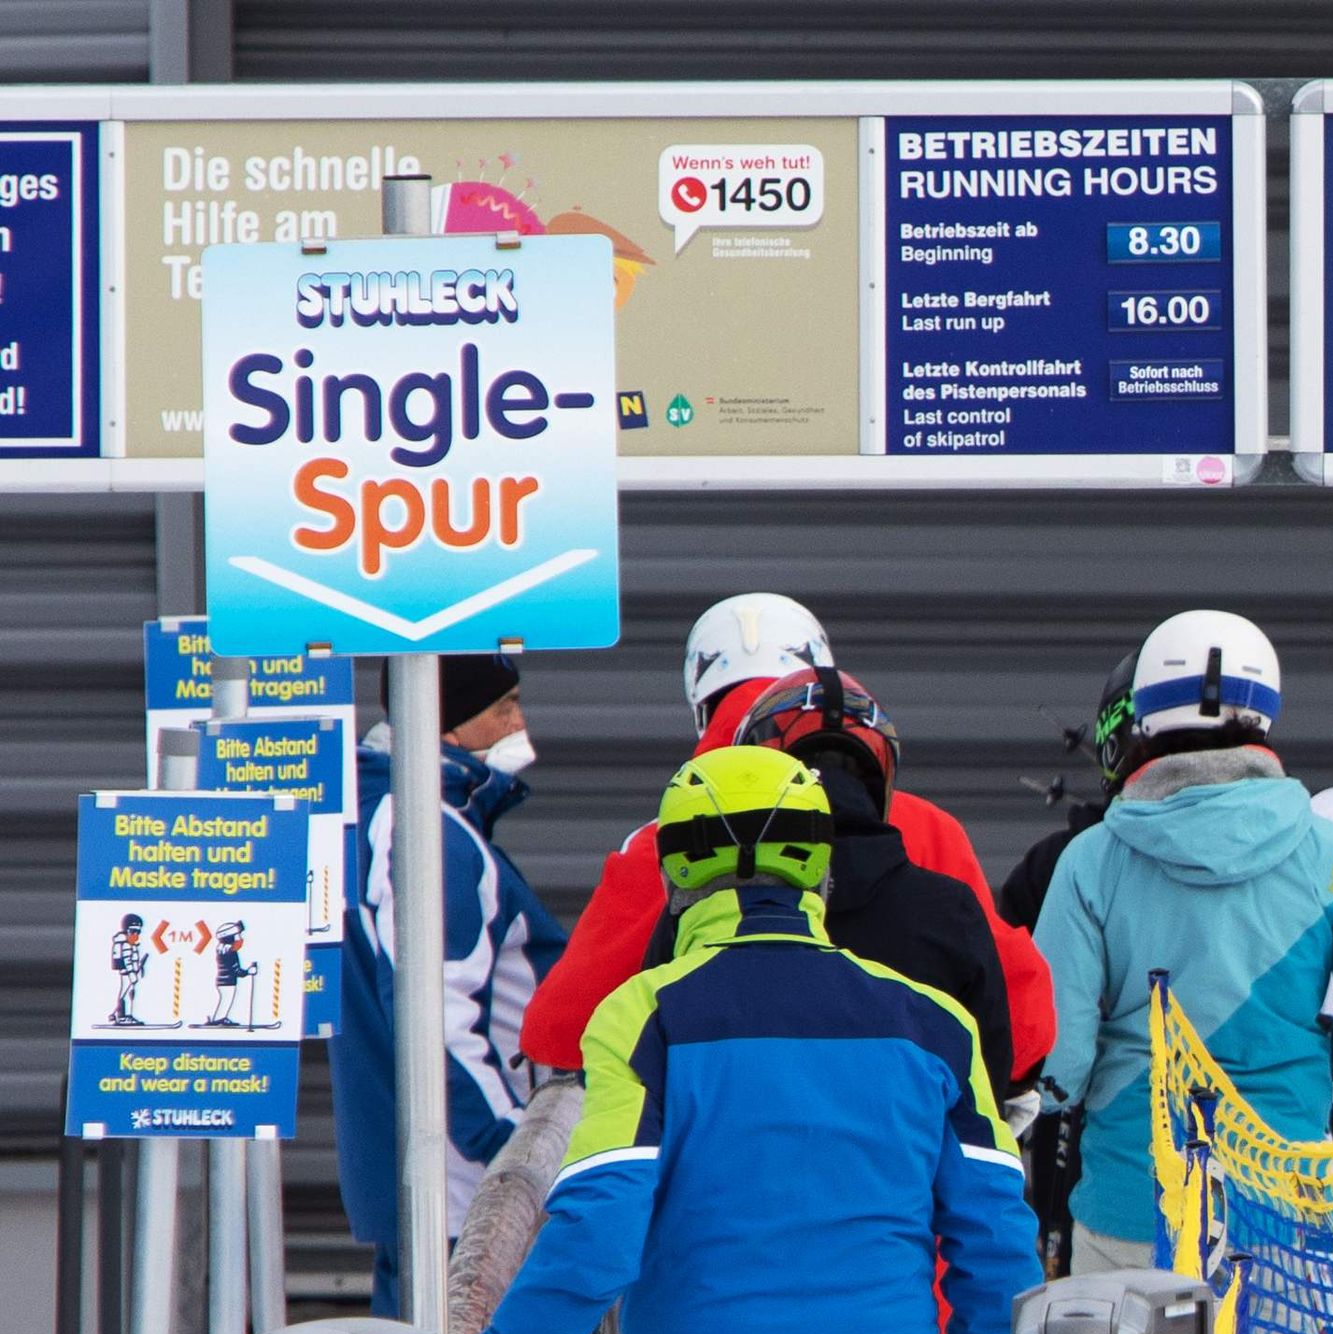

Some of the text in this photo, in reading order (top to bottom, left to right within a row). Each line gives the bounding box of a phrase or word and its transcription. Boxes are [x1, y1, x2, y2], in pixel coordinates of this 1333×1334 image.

[900, 128, 1217, 159] BETRIEBSZEITEN
[163, 146, 230, 191] Die
[673, 157, 810, 169] Wenn's weh tut!
[900, 167, 1217, 198] RUNNING HOURS
[711, 177, 811, 211] 1450
[163, 201, 336, 245] Hilfe am
[901, 222, 1038, 239] Betriebszeit ab
[1128, 226, 1200, 255] 8.30
[901, 246, 993, 263] Beginning
[297, 268, 517, 329] STUHLECK
[902, 291, 1050, 310] Letzte Bergfahrt
[1121, 296, 1209, 324] 16.00
[902, 316, 1004, 334] Last run up
[903, 360, 1081, 378] Letzte Kontrollfahrt
[1130, 365, 1202, 379] Sofort nach
[903, 383, 1087, 401] des Pistenpersonals
[1118, 380, 1218, 393] Betriebsschluss
[229, 343, 594, 466] Single-
[904, 409, 1010, 424] Last control
[904, 431, 1004, 450] of skipatrol
[293, 458, 539, 575] Spur
[263, 655, 303, 674] und
[250, 677, 325, 700] tragen!
[216, 734, 316, 758] Bitte Abstand
[226, 758, 307, 782] halten und
[115, 814, 267, 837] Bitte Abstand
[129, 841, 251, 863] halten und
[109, 868, 275, 893] Maske tragen!
[120, 1053, 250, 1075] Keep distance
[99, 1075, 267, 1093] and wear a mask!
[153, 1110, 233, 1129] STUHLECK
